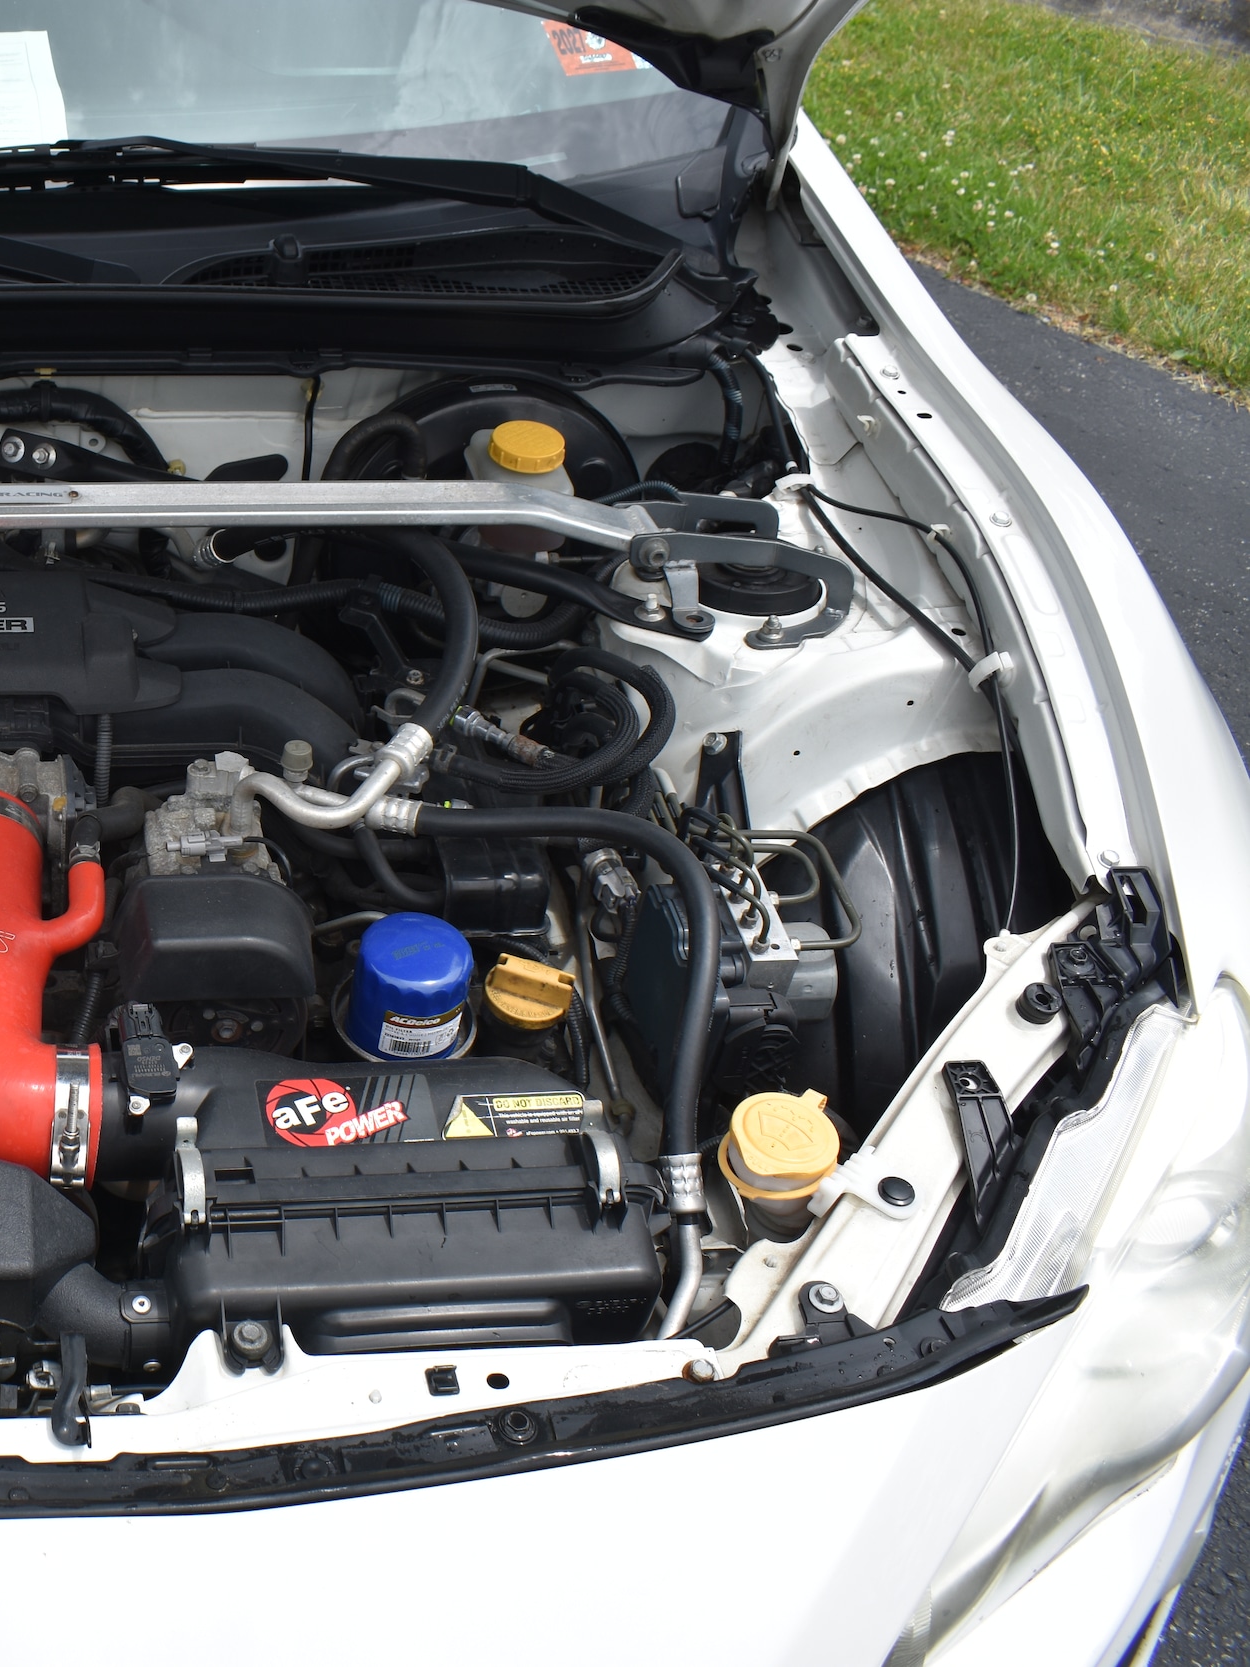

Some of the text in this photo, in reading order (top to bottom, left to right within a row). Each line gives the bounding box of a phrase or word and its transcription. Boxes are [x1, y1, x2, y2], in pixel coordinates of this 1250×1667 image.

[552, 28, 586, 56] 2027
[389, 1016, 441, 1026] ACDelco
[272, 1091, 350, 1130] aFe
[495, 1096, 580, 1109] DO NOT DISCARD
[324, 1101, 409, 1146] POWER
